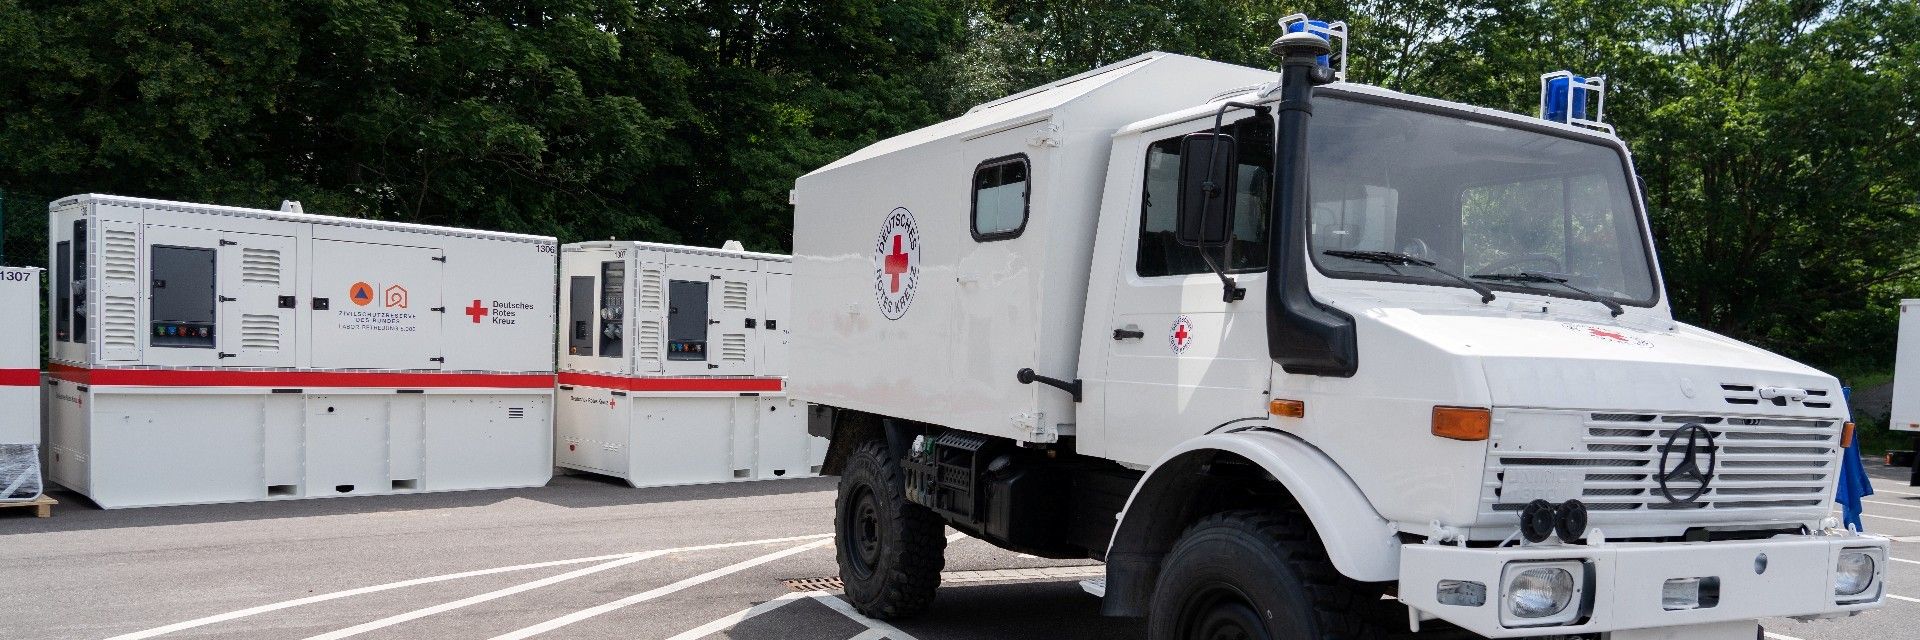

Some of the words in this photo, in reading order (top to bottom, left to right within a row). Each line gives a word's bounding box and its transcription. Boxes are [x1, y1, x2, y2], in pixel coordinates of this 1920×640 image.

[878, 213, 917, 254] DEUTSCHES
[536, 245, 555, 253] 1306
[0, 271, 31, 281] 1307
[876, 268, 893, 314] ROTES
[894, 265, 917, 313] KREUZ
[492, 300, 534, 310] Deutsches
[492, 308, 516, 316] Rotes
[492, 316, 515, 325] Kreuz
